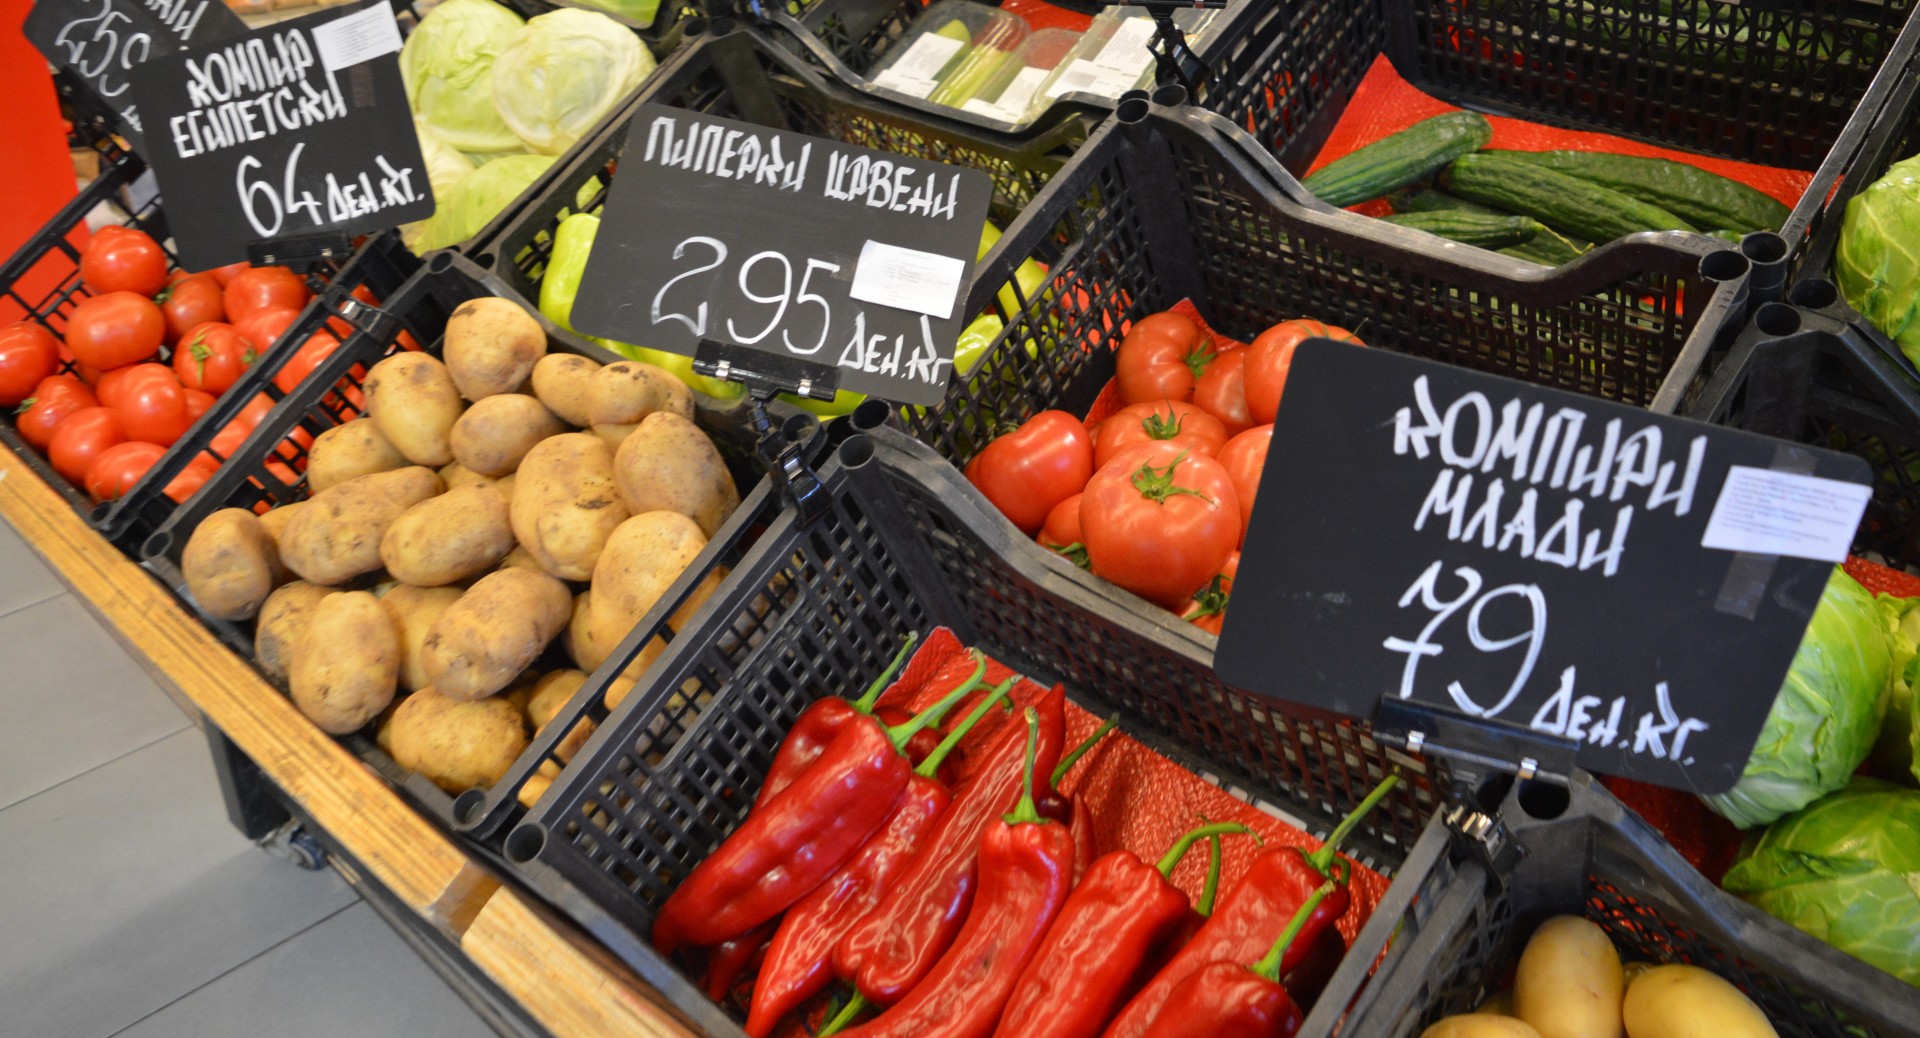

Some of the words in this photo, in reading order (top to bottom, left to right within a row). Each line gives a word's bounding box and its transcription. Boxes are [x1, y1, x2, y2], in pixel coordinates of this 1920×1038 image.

[170, 71, 347, 158] ЕГИПЕТСКИ
[186, 28, 315, 108] КОМПИР
[237, 142, 324, 238] 64
[644, 116, 812, 193] ПИПЕРКИ
[824, 149, 961, 221] ЦРВЕНИ
[651, 235, 841, 356] 295
[1394, 374, 1708, 517] КОМПИРИ
[1414, 468, 1634, 577] МЛАДИ
[1383, 560, 1548, 720] 79
